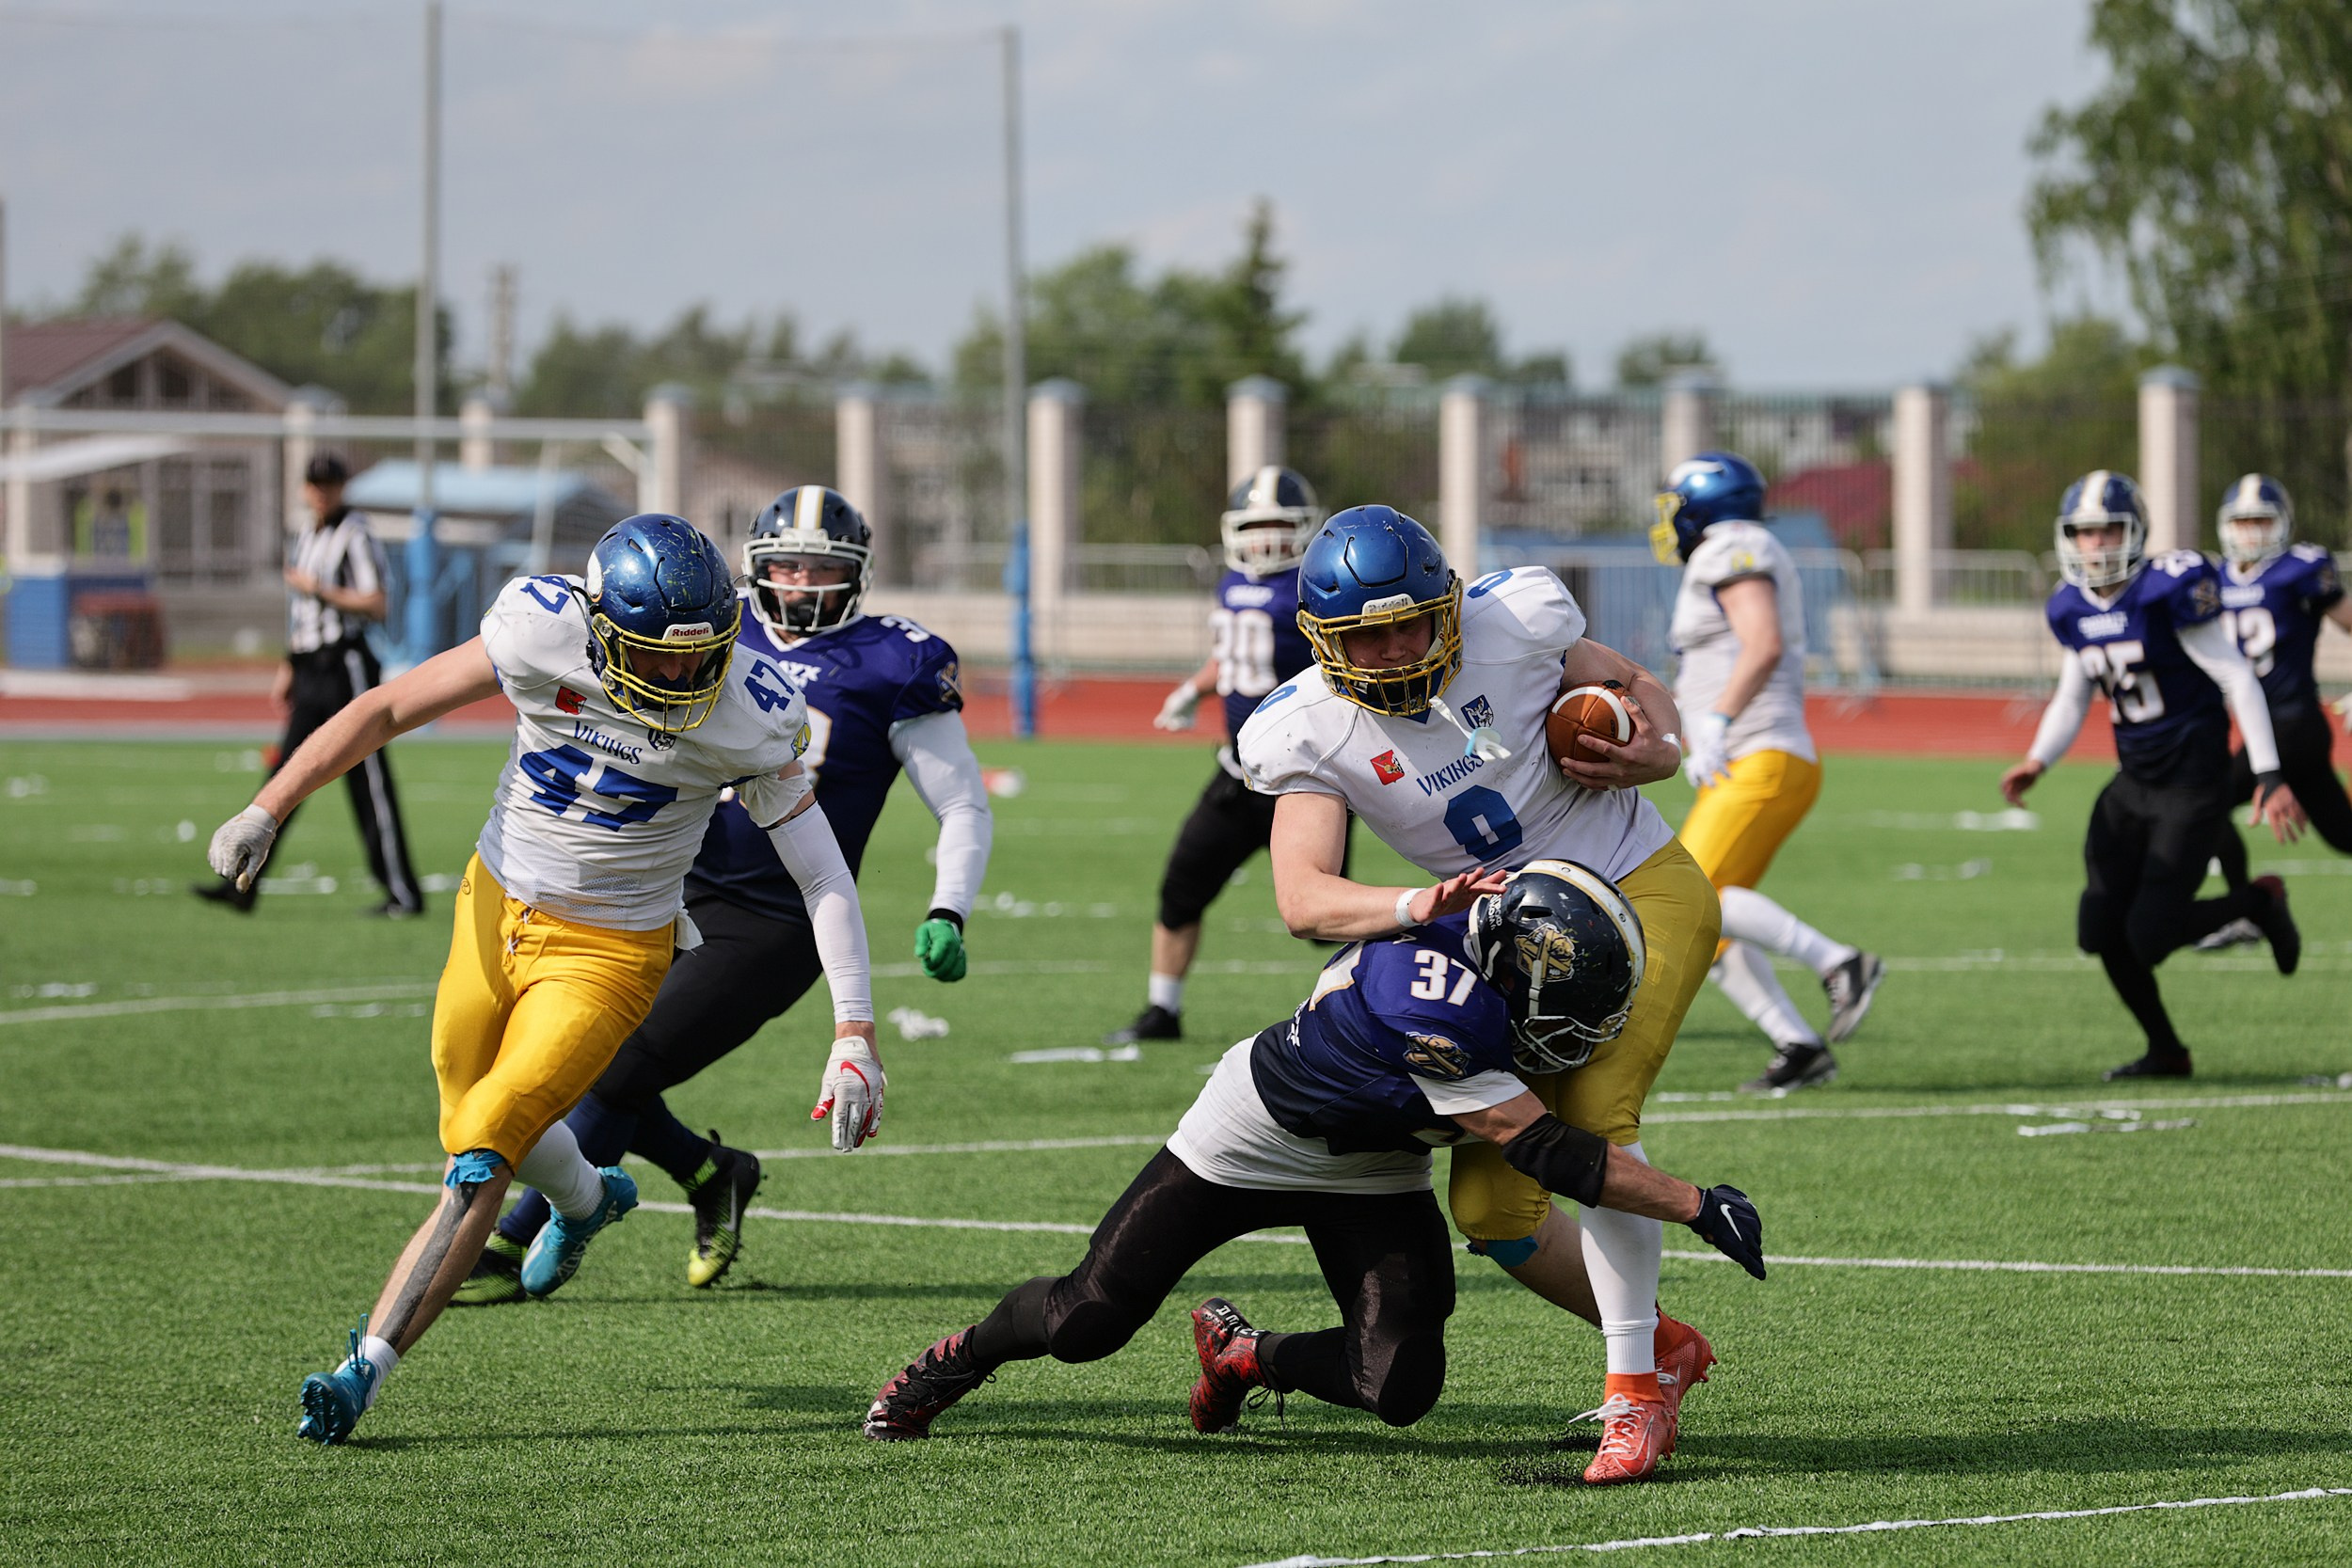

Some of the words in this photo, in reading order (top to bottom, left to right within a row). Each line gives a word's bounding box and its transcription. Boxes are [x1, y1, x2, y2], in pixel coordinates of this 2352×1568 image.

[672, 626, 709, 637] Riddell
[744, 659, 795, 713] 47
[574, 721, 643, 765] VIKINGS
[519, 743, 678, 832] 47
[1416, 752, 1485, 798] VIKINGS
[1410, 949, 1478, 1006] 37
